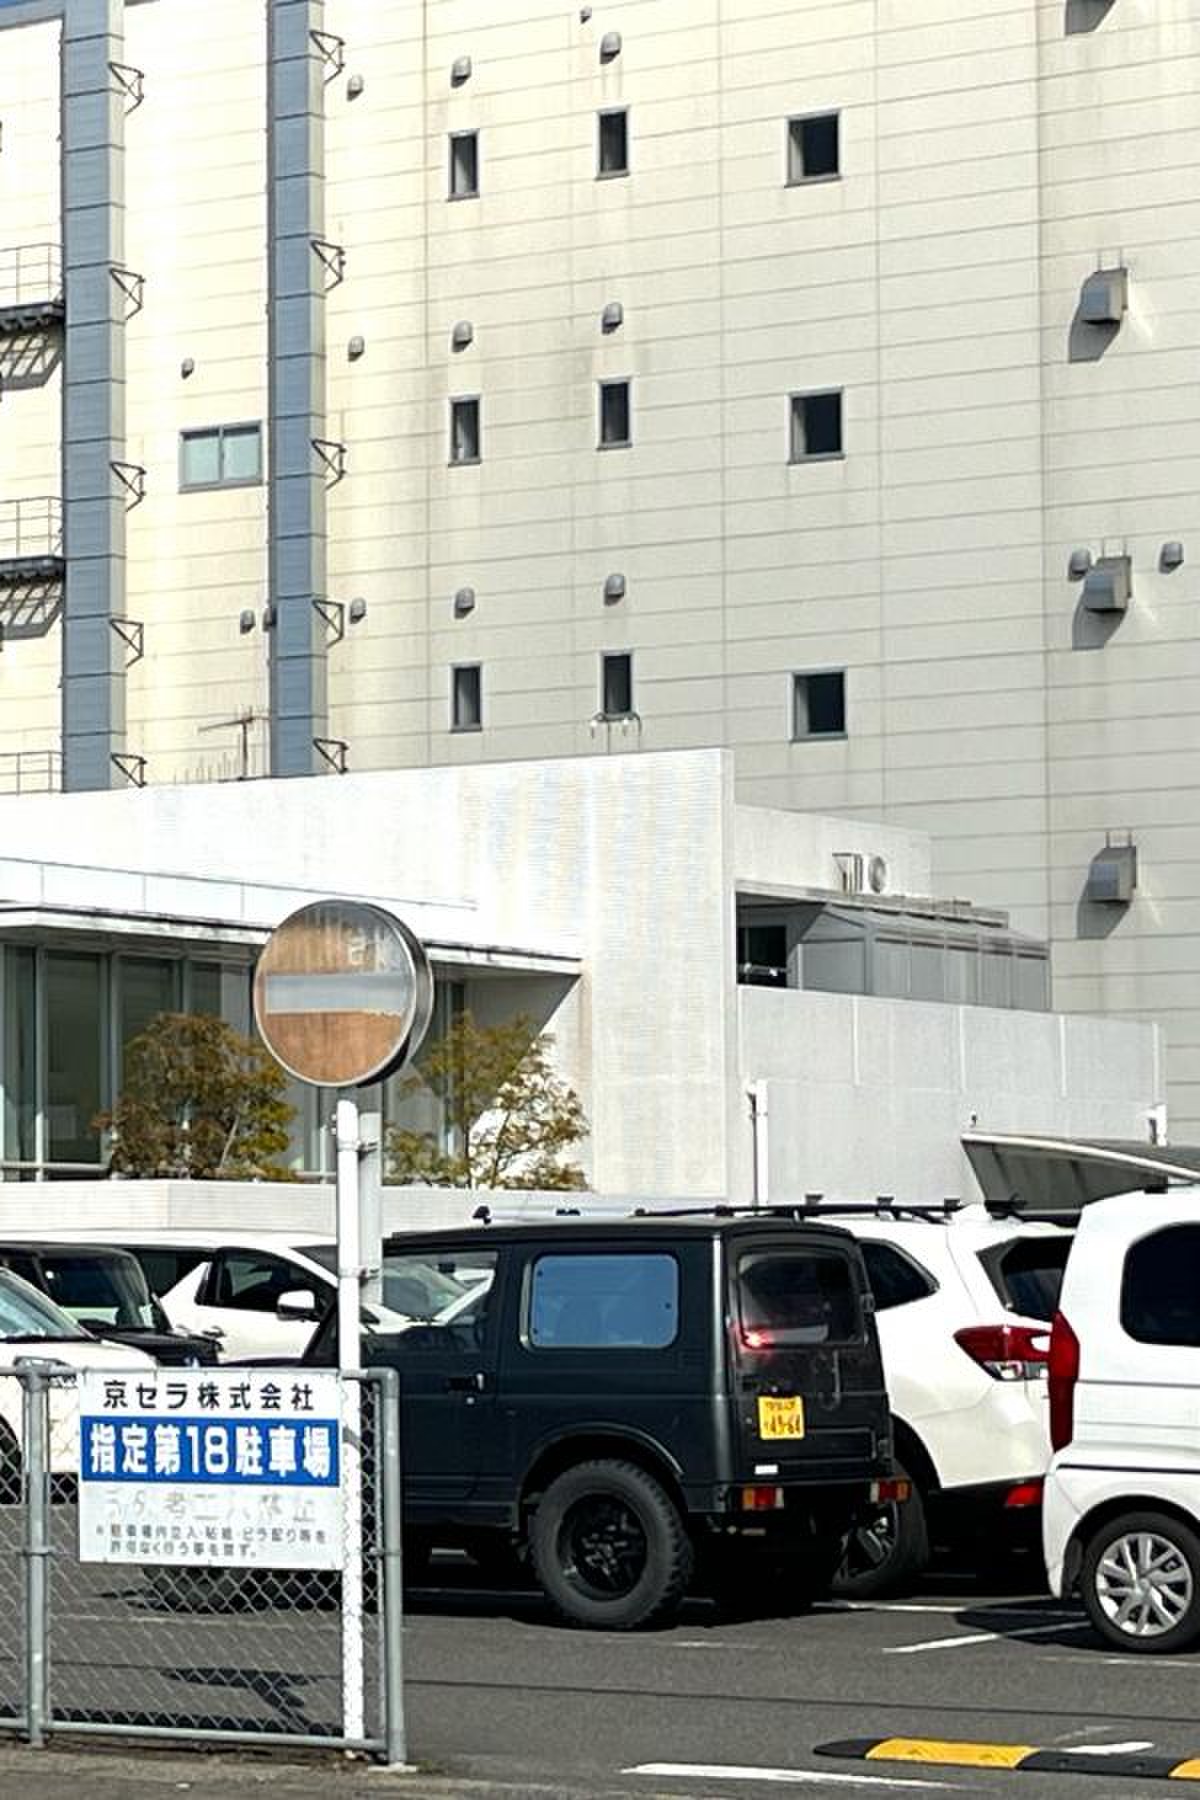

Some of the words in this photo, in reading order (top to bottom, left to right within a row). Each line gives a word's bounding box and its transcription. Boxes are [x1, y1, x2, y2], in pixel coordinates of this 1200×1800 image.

[103, 1380, 314, 1411] 京セラ株式会社
[90, 1423, 330, 1478] 指定第18駐車場
